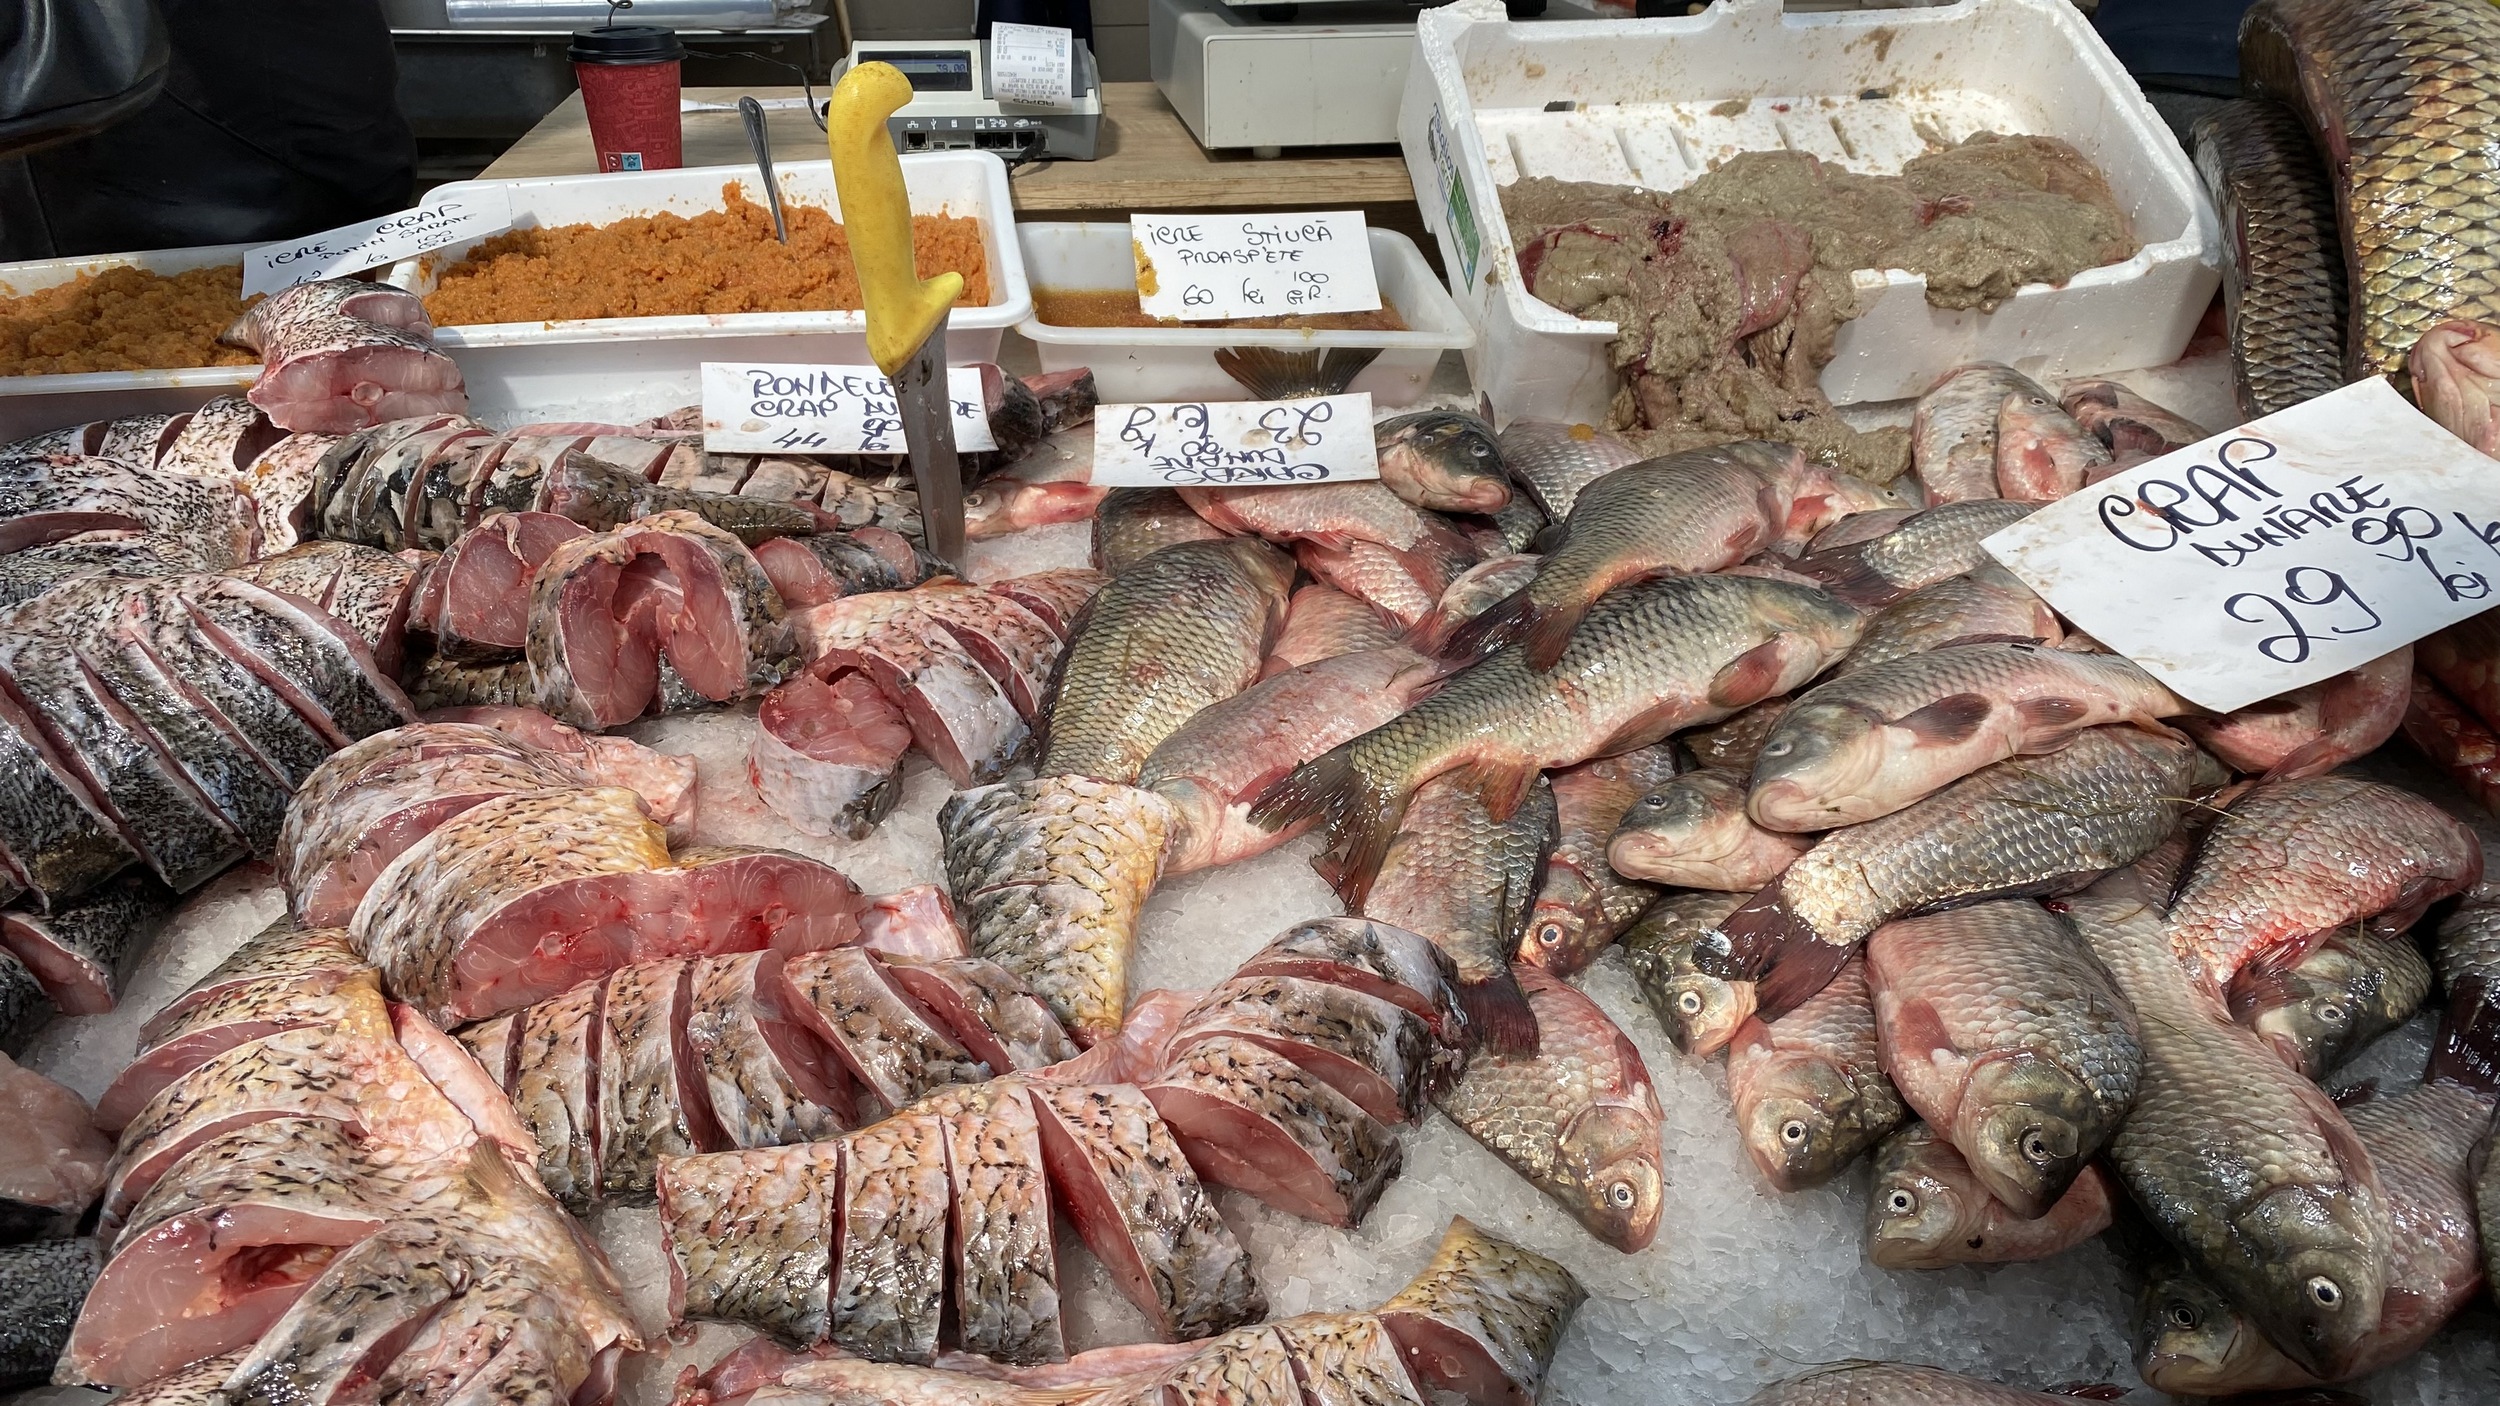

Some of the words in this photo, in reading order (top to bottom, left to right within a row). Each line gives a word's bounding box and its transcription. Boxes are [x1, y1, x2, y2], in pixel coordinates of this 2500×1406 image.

[376, 203, 463, 234] CRAP
[1293, 271, 1329, 283] 100
[1183, 285, 1214, 306] 60
[750, 399, 838, 418] CRAP
[1258, 402, 1333, 446] 23
[773, 429, 828, 448] 44
[2098, 437, 2284, 552] CRAP
[2224, 566, 2382, 664] 29
